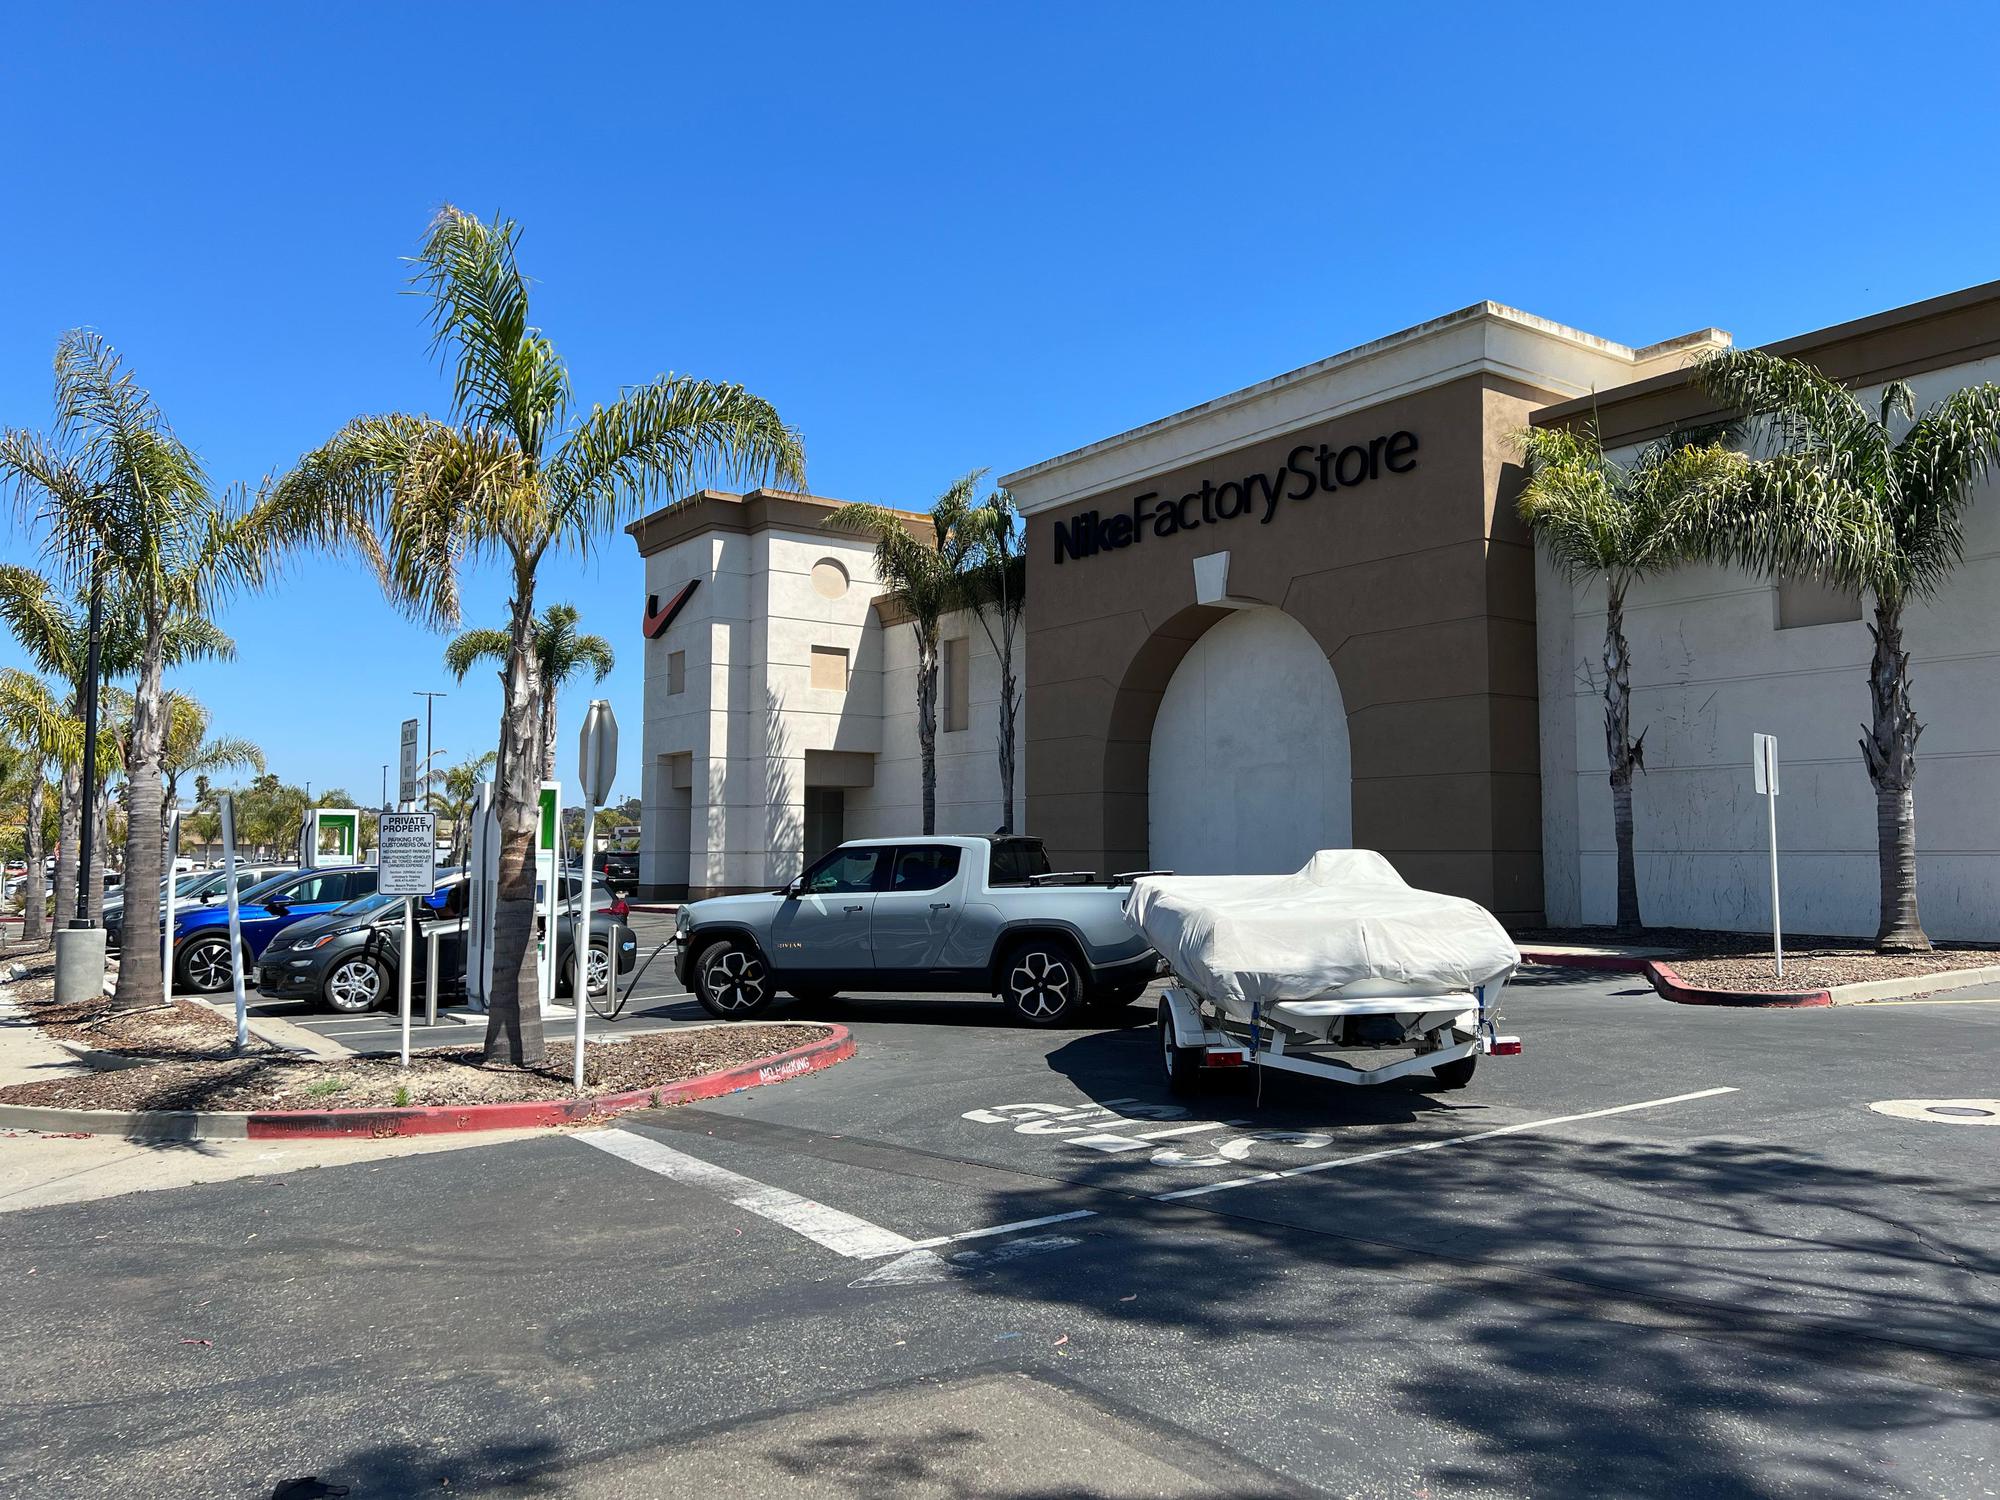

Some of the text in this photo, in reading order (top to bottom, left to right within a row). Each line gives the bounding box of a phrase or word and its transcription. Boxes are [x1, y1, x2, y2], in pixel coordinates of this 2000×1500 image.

[388, 817, 426, 825] PRIVATE
[382, 825, 432, 833] PROPERTY
[759, 1056, 810, 1082] NO PARKING
